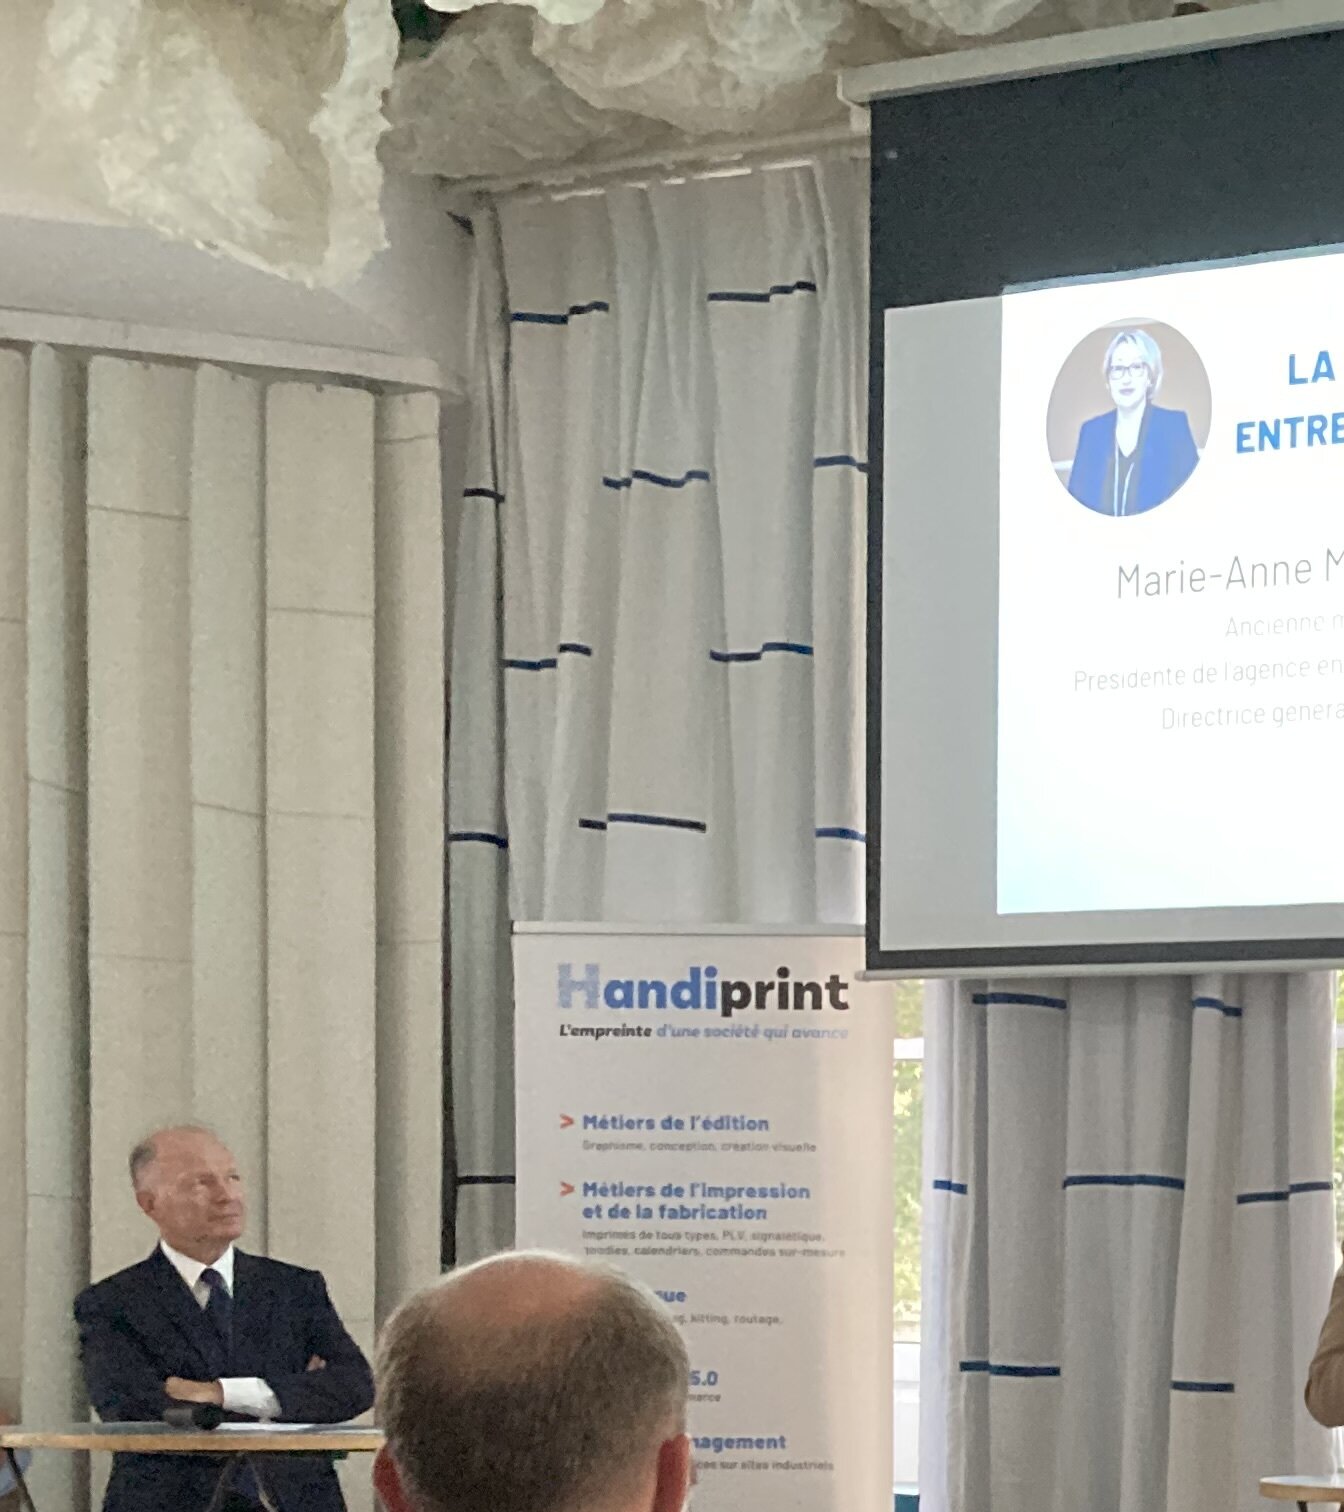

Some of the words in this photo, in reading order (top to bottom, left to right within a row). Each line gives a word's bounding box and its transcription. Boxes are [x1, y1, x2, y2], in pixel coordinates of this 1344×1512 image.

[1288, 350, 1336, 386] LA
[1117, 555, 1313, 599] Marie-Anne
[1193, 661, 1218, 686] de
[1162, 706, 1266, 731] Directrice
[558, 963, 850, 1017] Handiprint
[559, 1023, 652, 1041] L'empreinte
[656, 1023, 700, 1039] d'une
[763, 1023, 788, 1041] qui
[582, 1115, 655, 1131] Métiers
[661, 1115, 685, 1131] de
[691, 1115, 770, 1132] l'édition
[582, 1182, 656, 1198] Métiers
[660, 1182, 685, 1198] de
[690, 1182, 811, 1201] l'impression
[582, 1205, 602, 1219] et
[608, 1204, 631, 1219] de
[636, 1204, 653, 1219] la
[659, 1204, 767, 1220] fabrication
